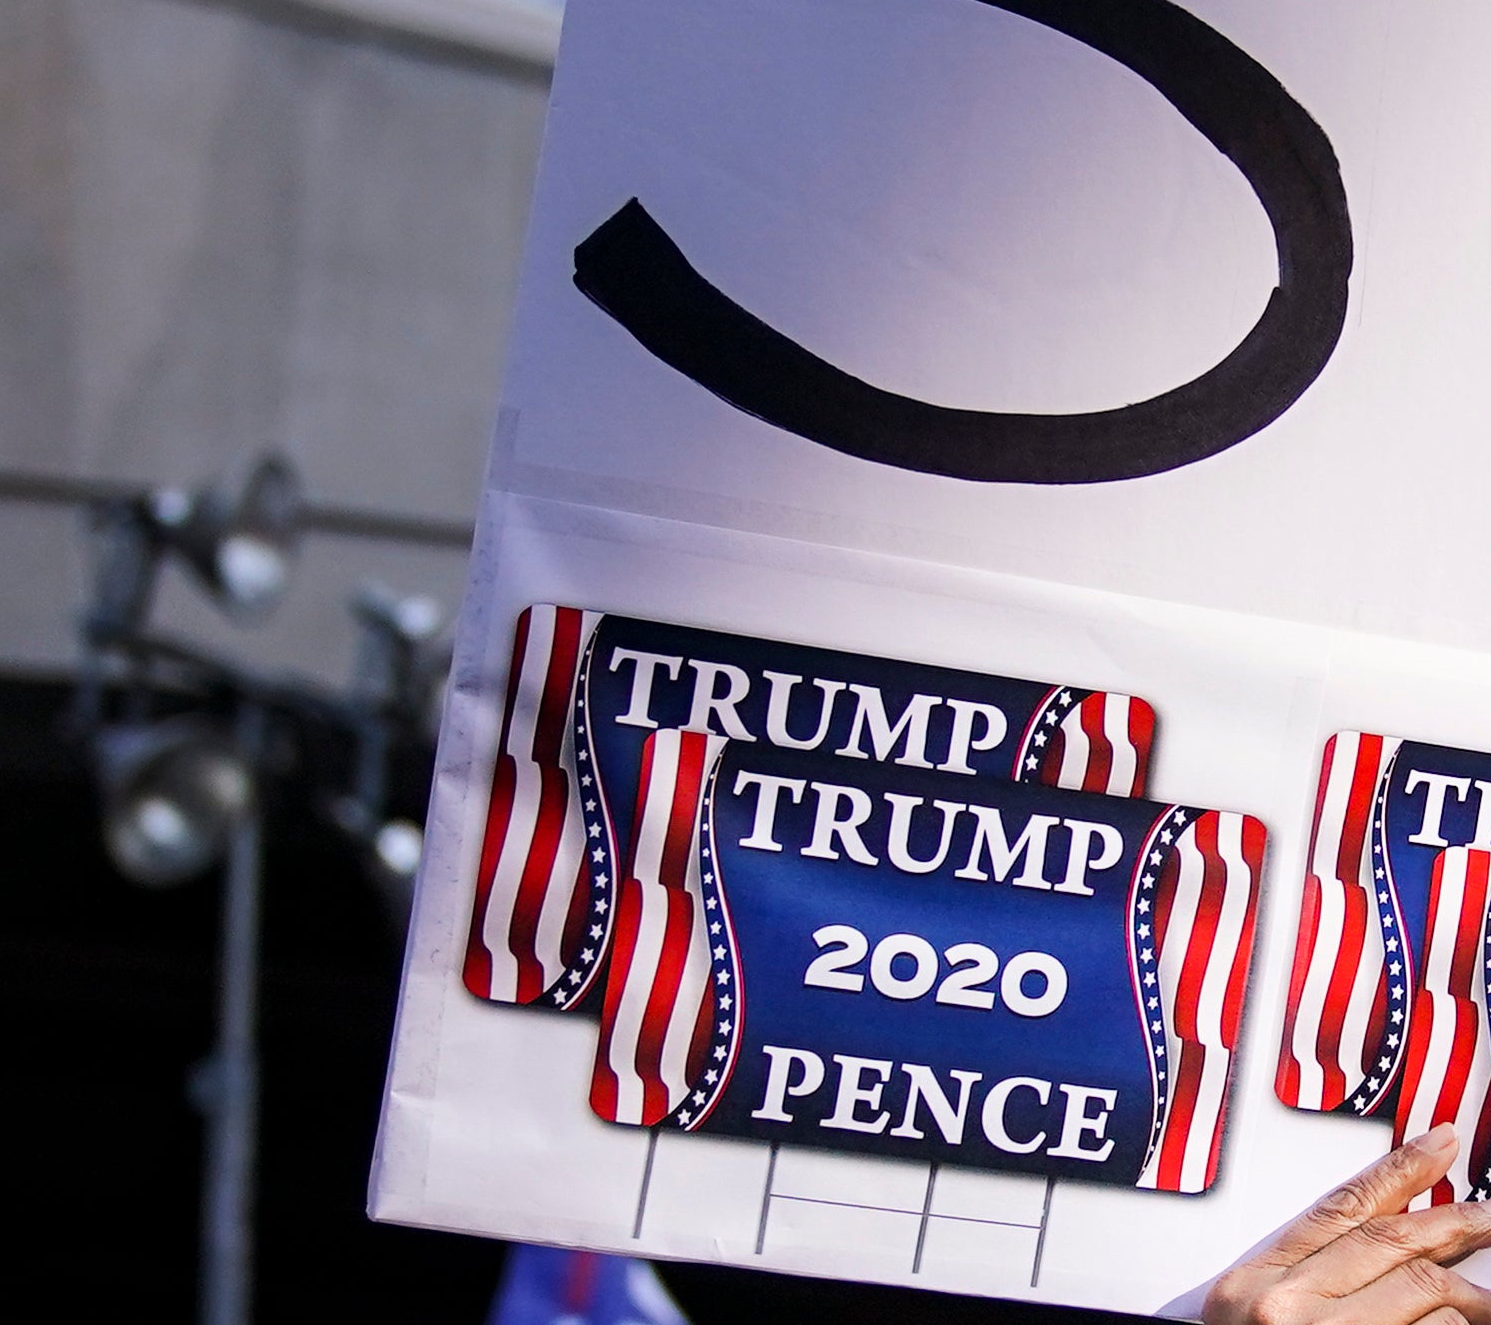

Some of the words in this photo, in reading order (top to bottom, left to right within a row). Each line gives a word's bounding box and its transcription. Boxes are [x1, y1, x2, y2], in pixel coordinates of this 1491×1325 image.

[609, 645, 1009, 776] TRUMP
[732, 769, 1125, 897] TRUMP
[802, 924, 1069, 1018] 2020
[750, 1044, 1120, 1164] PENCE
